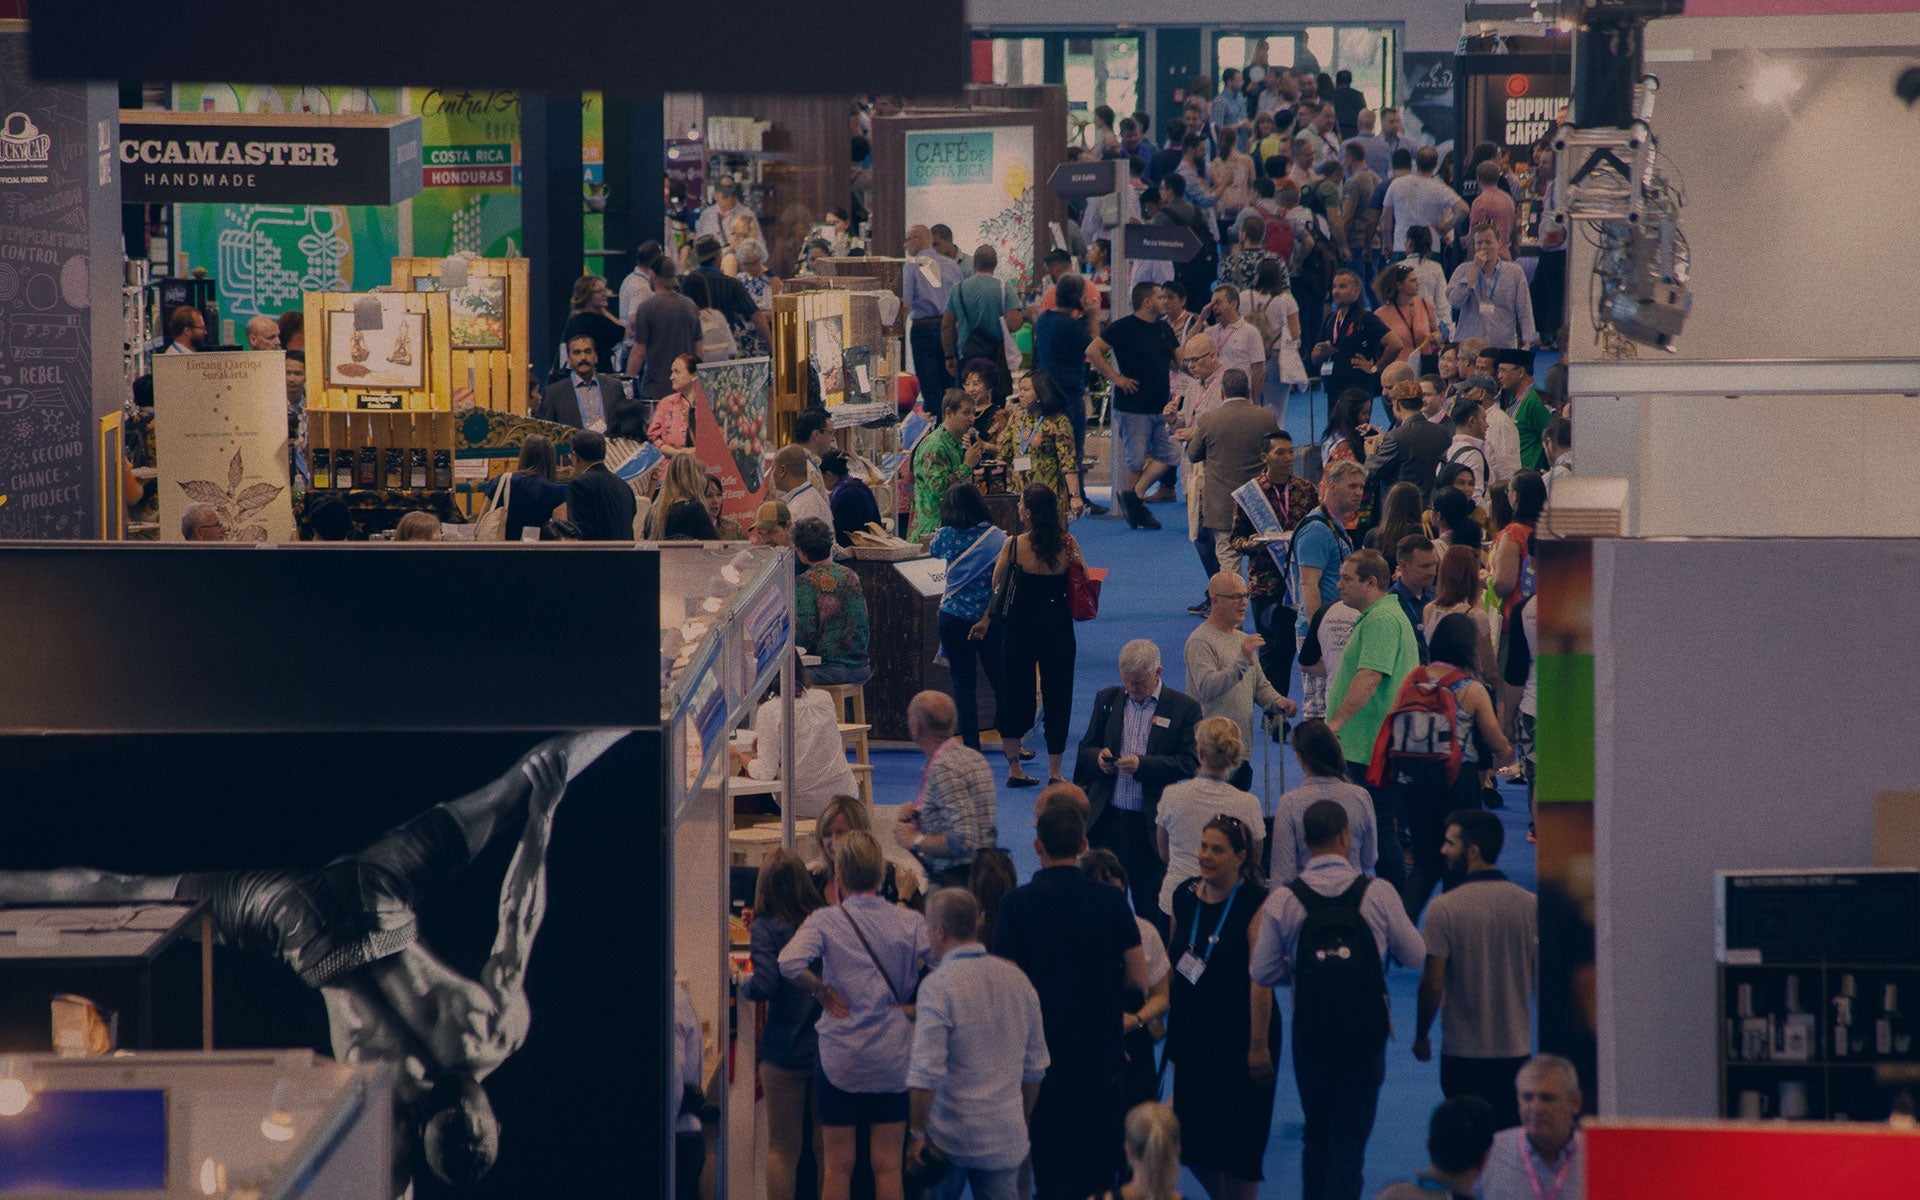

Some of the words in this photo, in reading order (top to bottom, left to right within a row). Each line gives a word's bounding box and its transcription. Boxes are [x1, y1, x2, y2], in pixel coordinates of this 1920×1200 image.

[28, 137, 48, 159] CAP
[119, 139, 339, 167] CCAMASTER
[431, 150, 475, 164] COSTA
[475, 149, 504, 162] RICA
[915, 136, 968, 163] CAFÉ
[144, 173, 256, 188] HANDMADE
[431, 170, 504, 184] HONDURAS
[1, 244, 60, 266] CONTROL
[20, 365, 64, 385] REBEL
[186, 360, 223, 373] Lintang
[202, 371, 248, 381] Surakarta
[32, 440, 83, 464] SECOND
[11, 468, 60, 491] CHANCE
[22, 484, 81, 511] PROJECT
